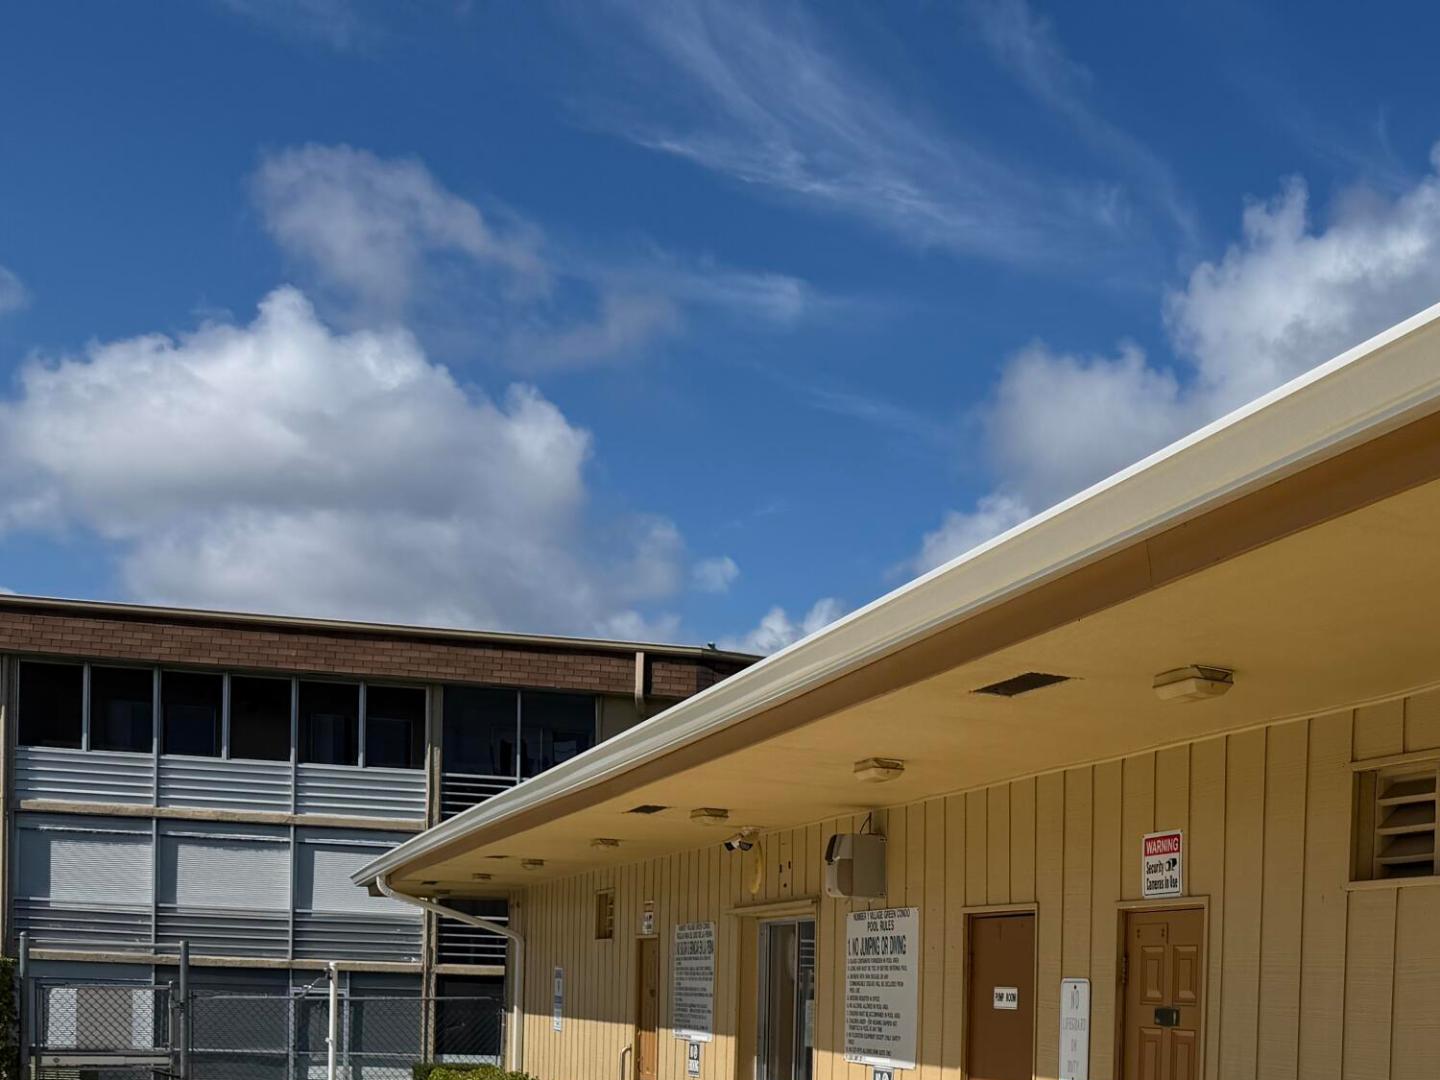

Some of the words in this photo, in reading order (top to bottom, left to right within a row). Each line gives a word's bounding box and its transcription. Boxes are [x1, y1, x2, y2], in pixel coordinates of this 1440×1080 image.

[1146, 838, 1178, 854] WARNING
[1146, 860, 1164, 875] Security
[1147, 878, 1163, 890] Cameras
[1170, 875, 1178, 888] Use
[867, 922, 878, 932] POOL
[880, 920, 894, 930] RULES
[852, 937, 858, 956] NO
[860, 936, 880, 956] JUMPING
[881, 936, 888, 955] OR
[890, 935, 906, 955] DIVING
[1071, 990, 1079, 1009] NO
